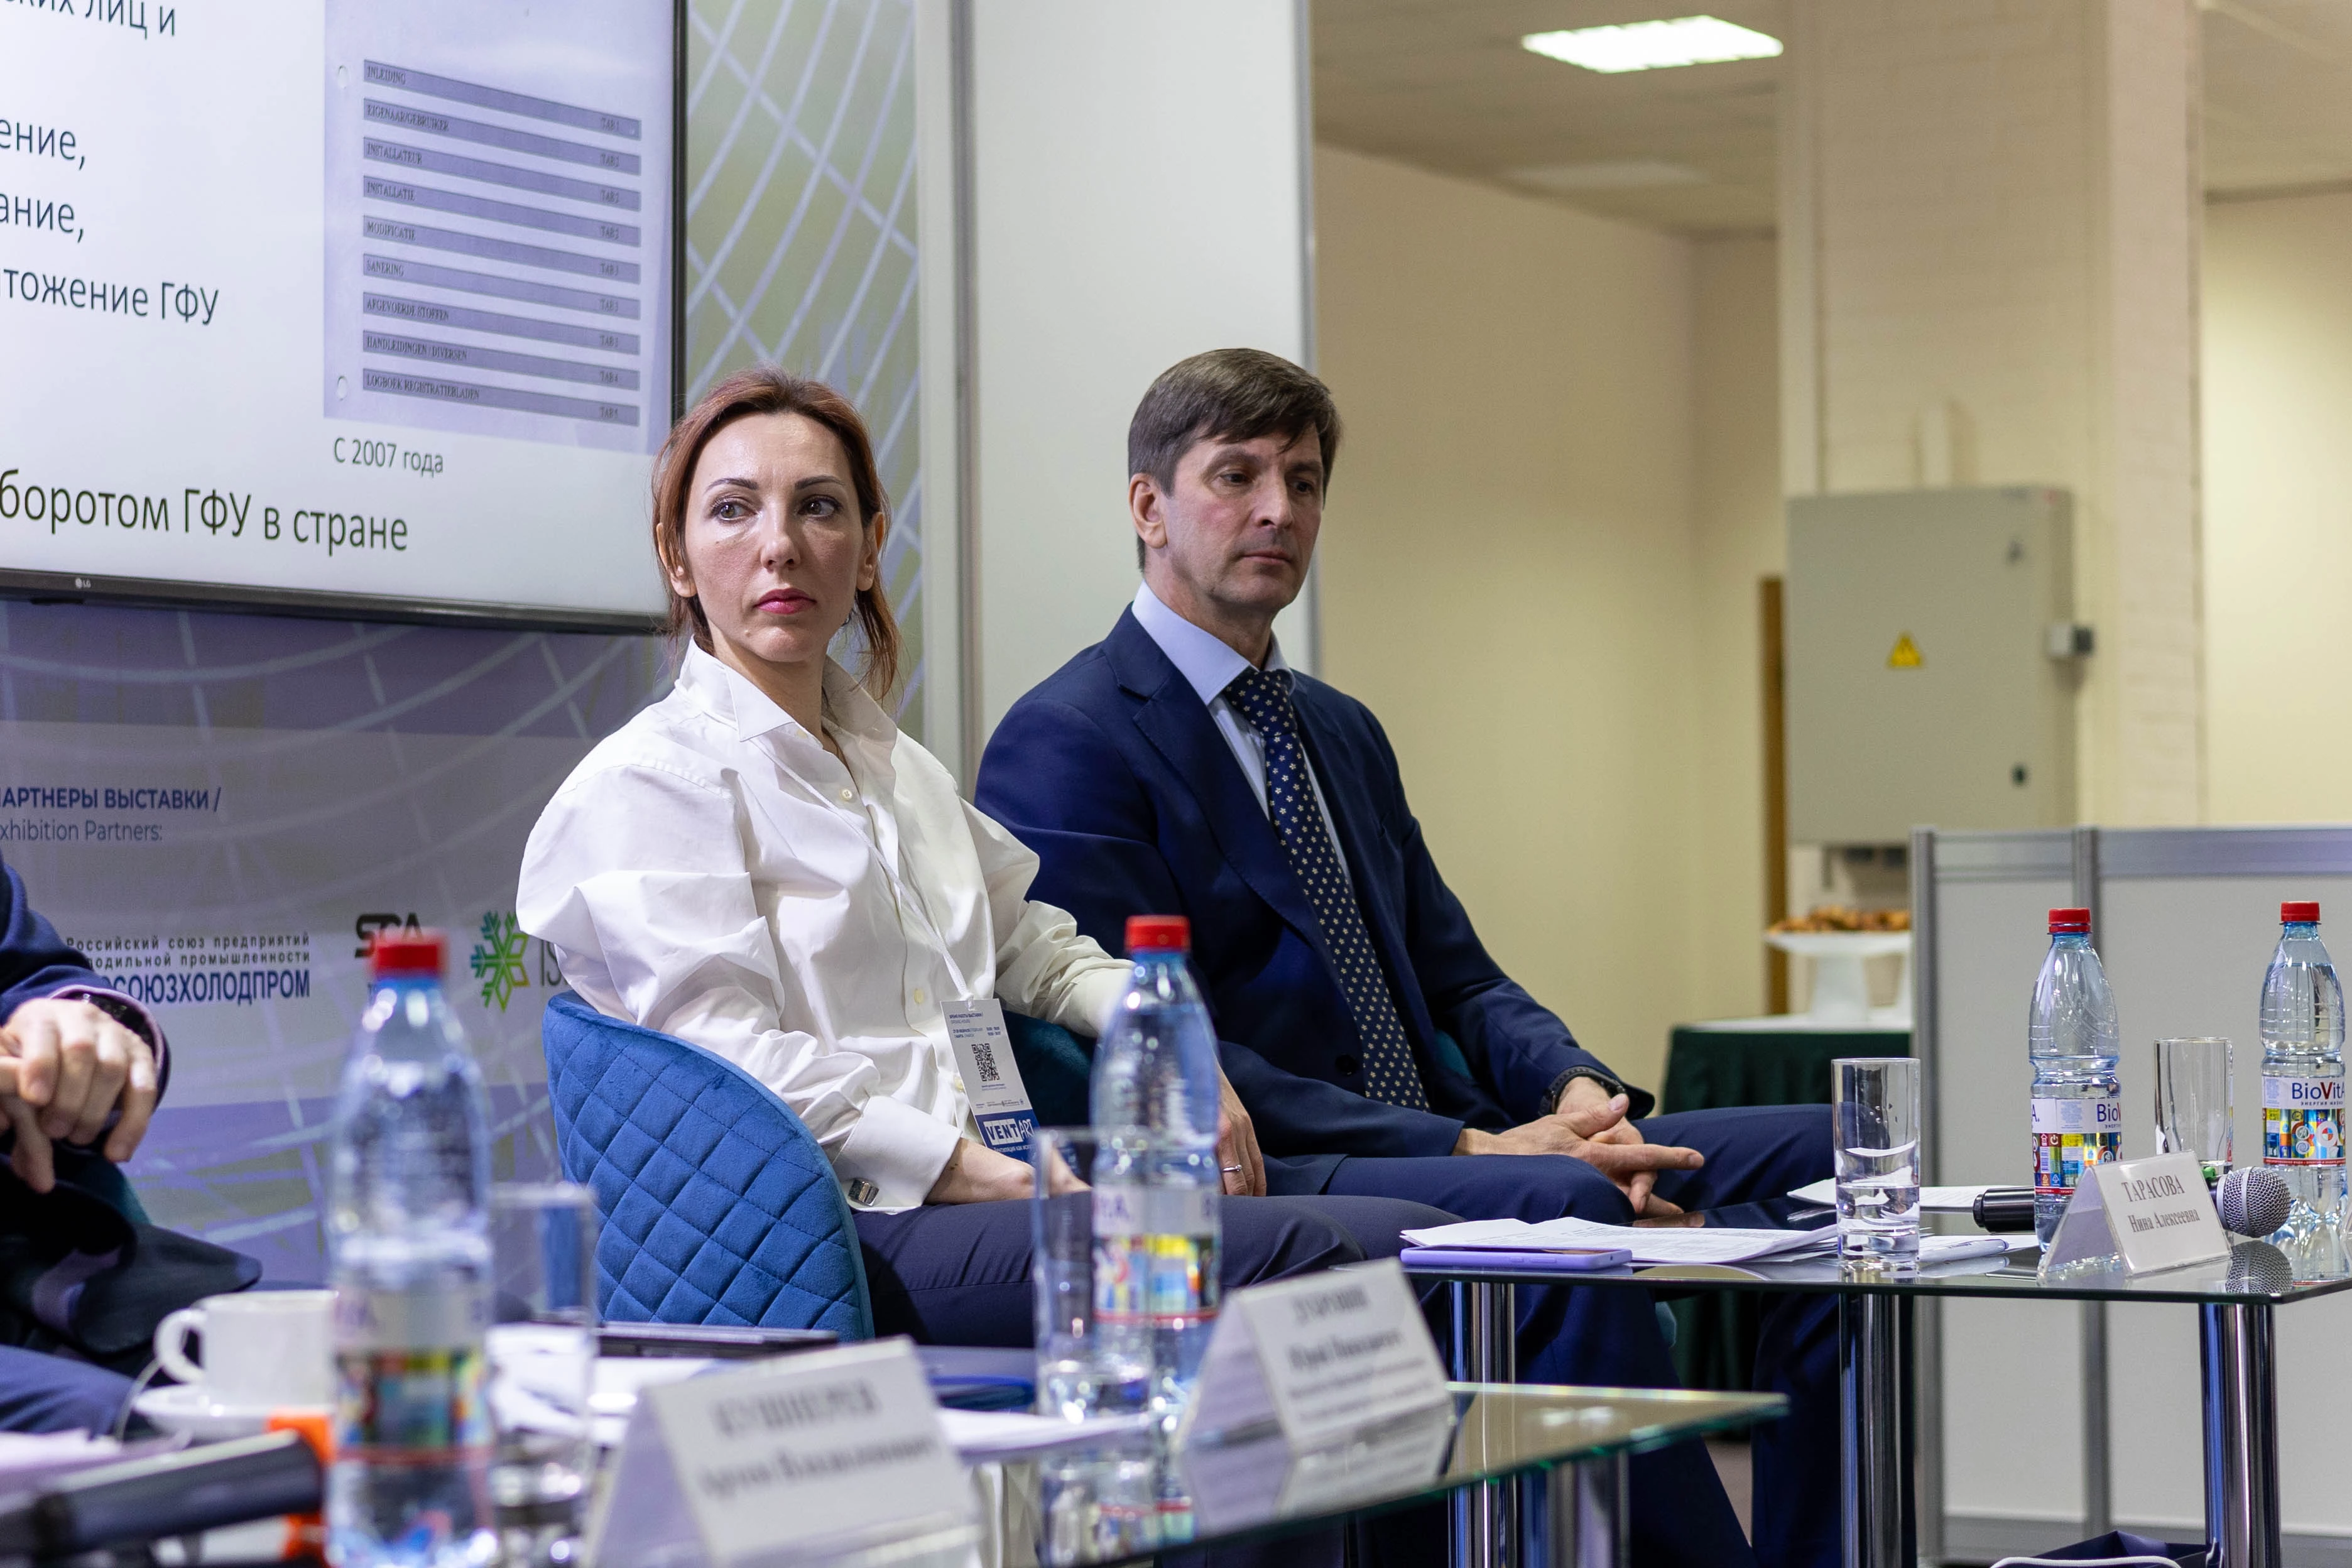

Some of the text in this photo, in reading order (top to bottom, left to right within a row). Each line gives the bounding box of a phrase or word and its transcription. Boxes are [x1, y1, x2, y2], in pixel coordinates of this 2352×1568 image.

[85, 0, 147, 40] лиц
[160, 6, 175, 36] и
[0, 117, 85, 170] ение,
[367, 143, 422, 165] INSTALLATEUR
[367, 182, 415, 201] INSTALLATIE
[3, 268, 219, 325] тожение ГФУ
[367, 374, 402, 390] LOGBOEK
[334, 437, 444, 478] С 2007 года
[0, 469, 408, 556] боротом ГФУ в стране
[0, 787, 221, 812] АРТНЕРЫ ВЫСТАВКИ /
[0, 819, 163, 842] xhibition Partners:
[169, 936, 205, 950] союз
[214, 931, 310, 950] предприятий
[181, 952, 310, 969] промышленности
[2121, 1174, 2185, 1202] ТАРАСОВА
[2128, 1209, 2200, 1233] Нина Алексеевна
